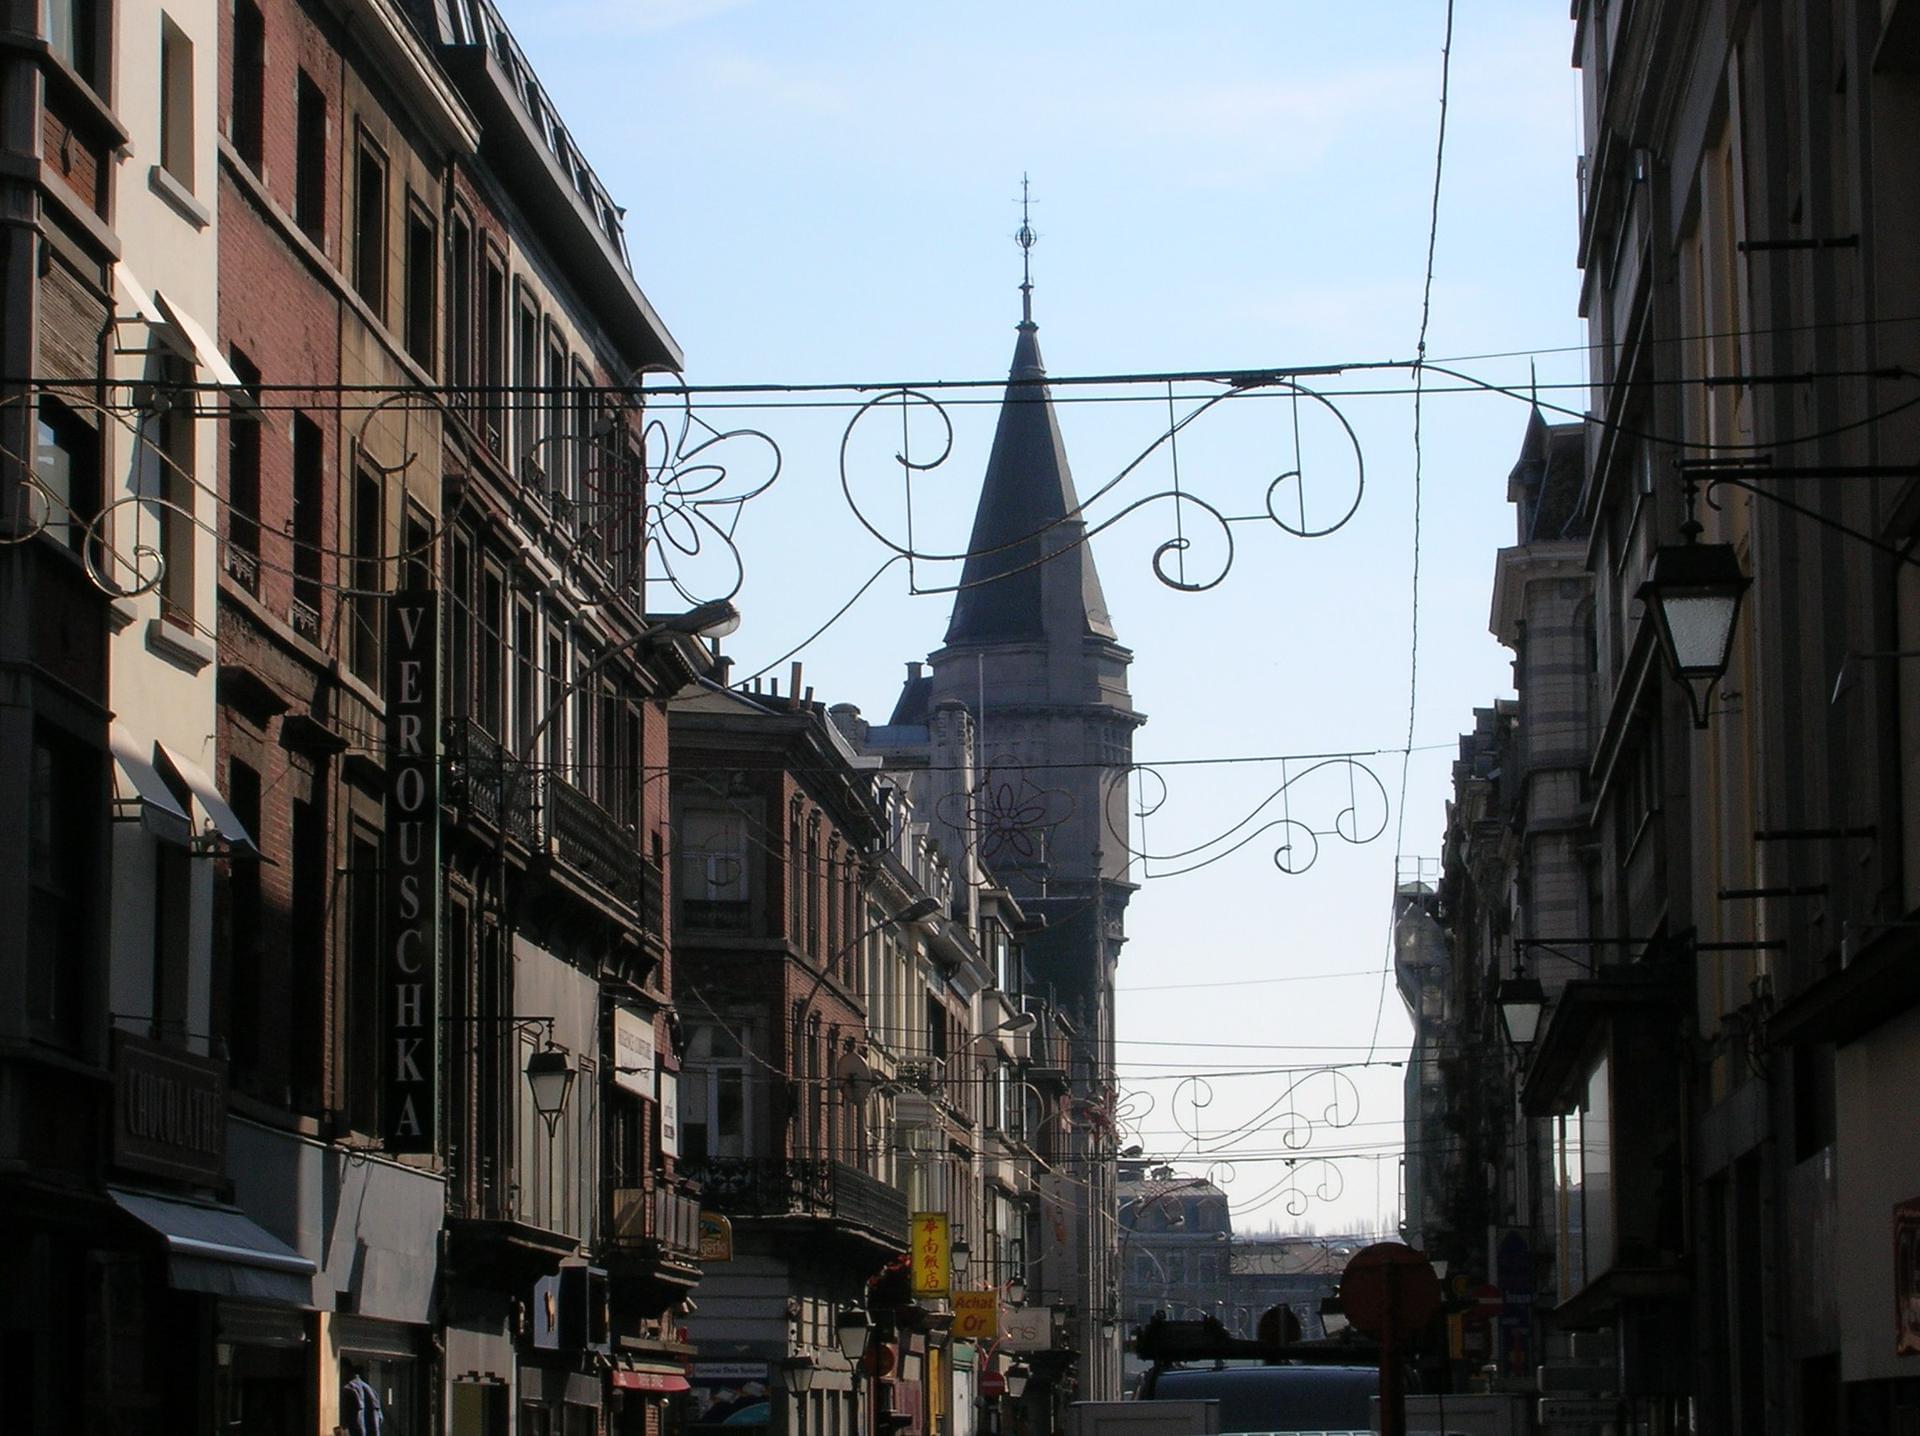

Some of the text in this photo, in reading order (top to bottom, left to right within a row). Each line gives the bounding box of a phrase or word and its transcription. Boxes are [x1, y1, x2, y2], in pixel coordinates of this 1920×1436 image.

[396, 607, 424, 1136] VEROUSCHKA
[955, 1297, 994, 1309] Achat
[963, 1315, 987, 1331] Or
